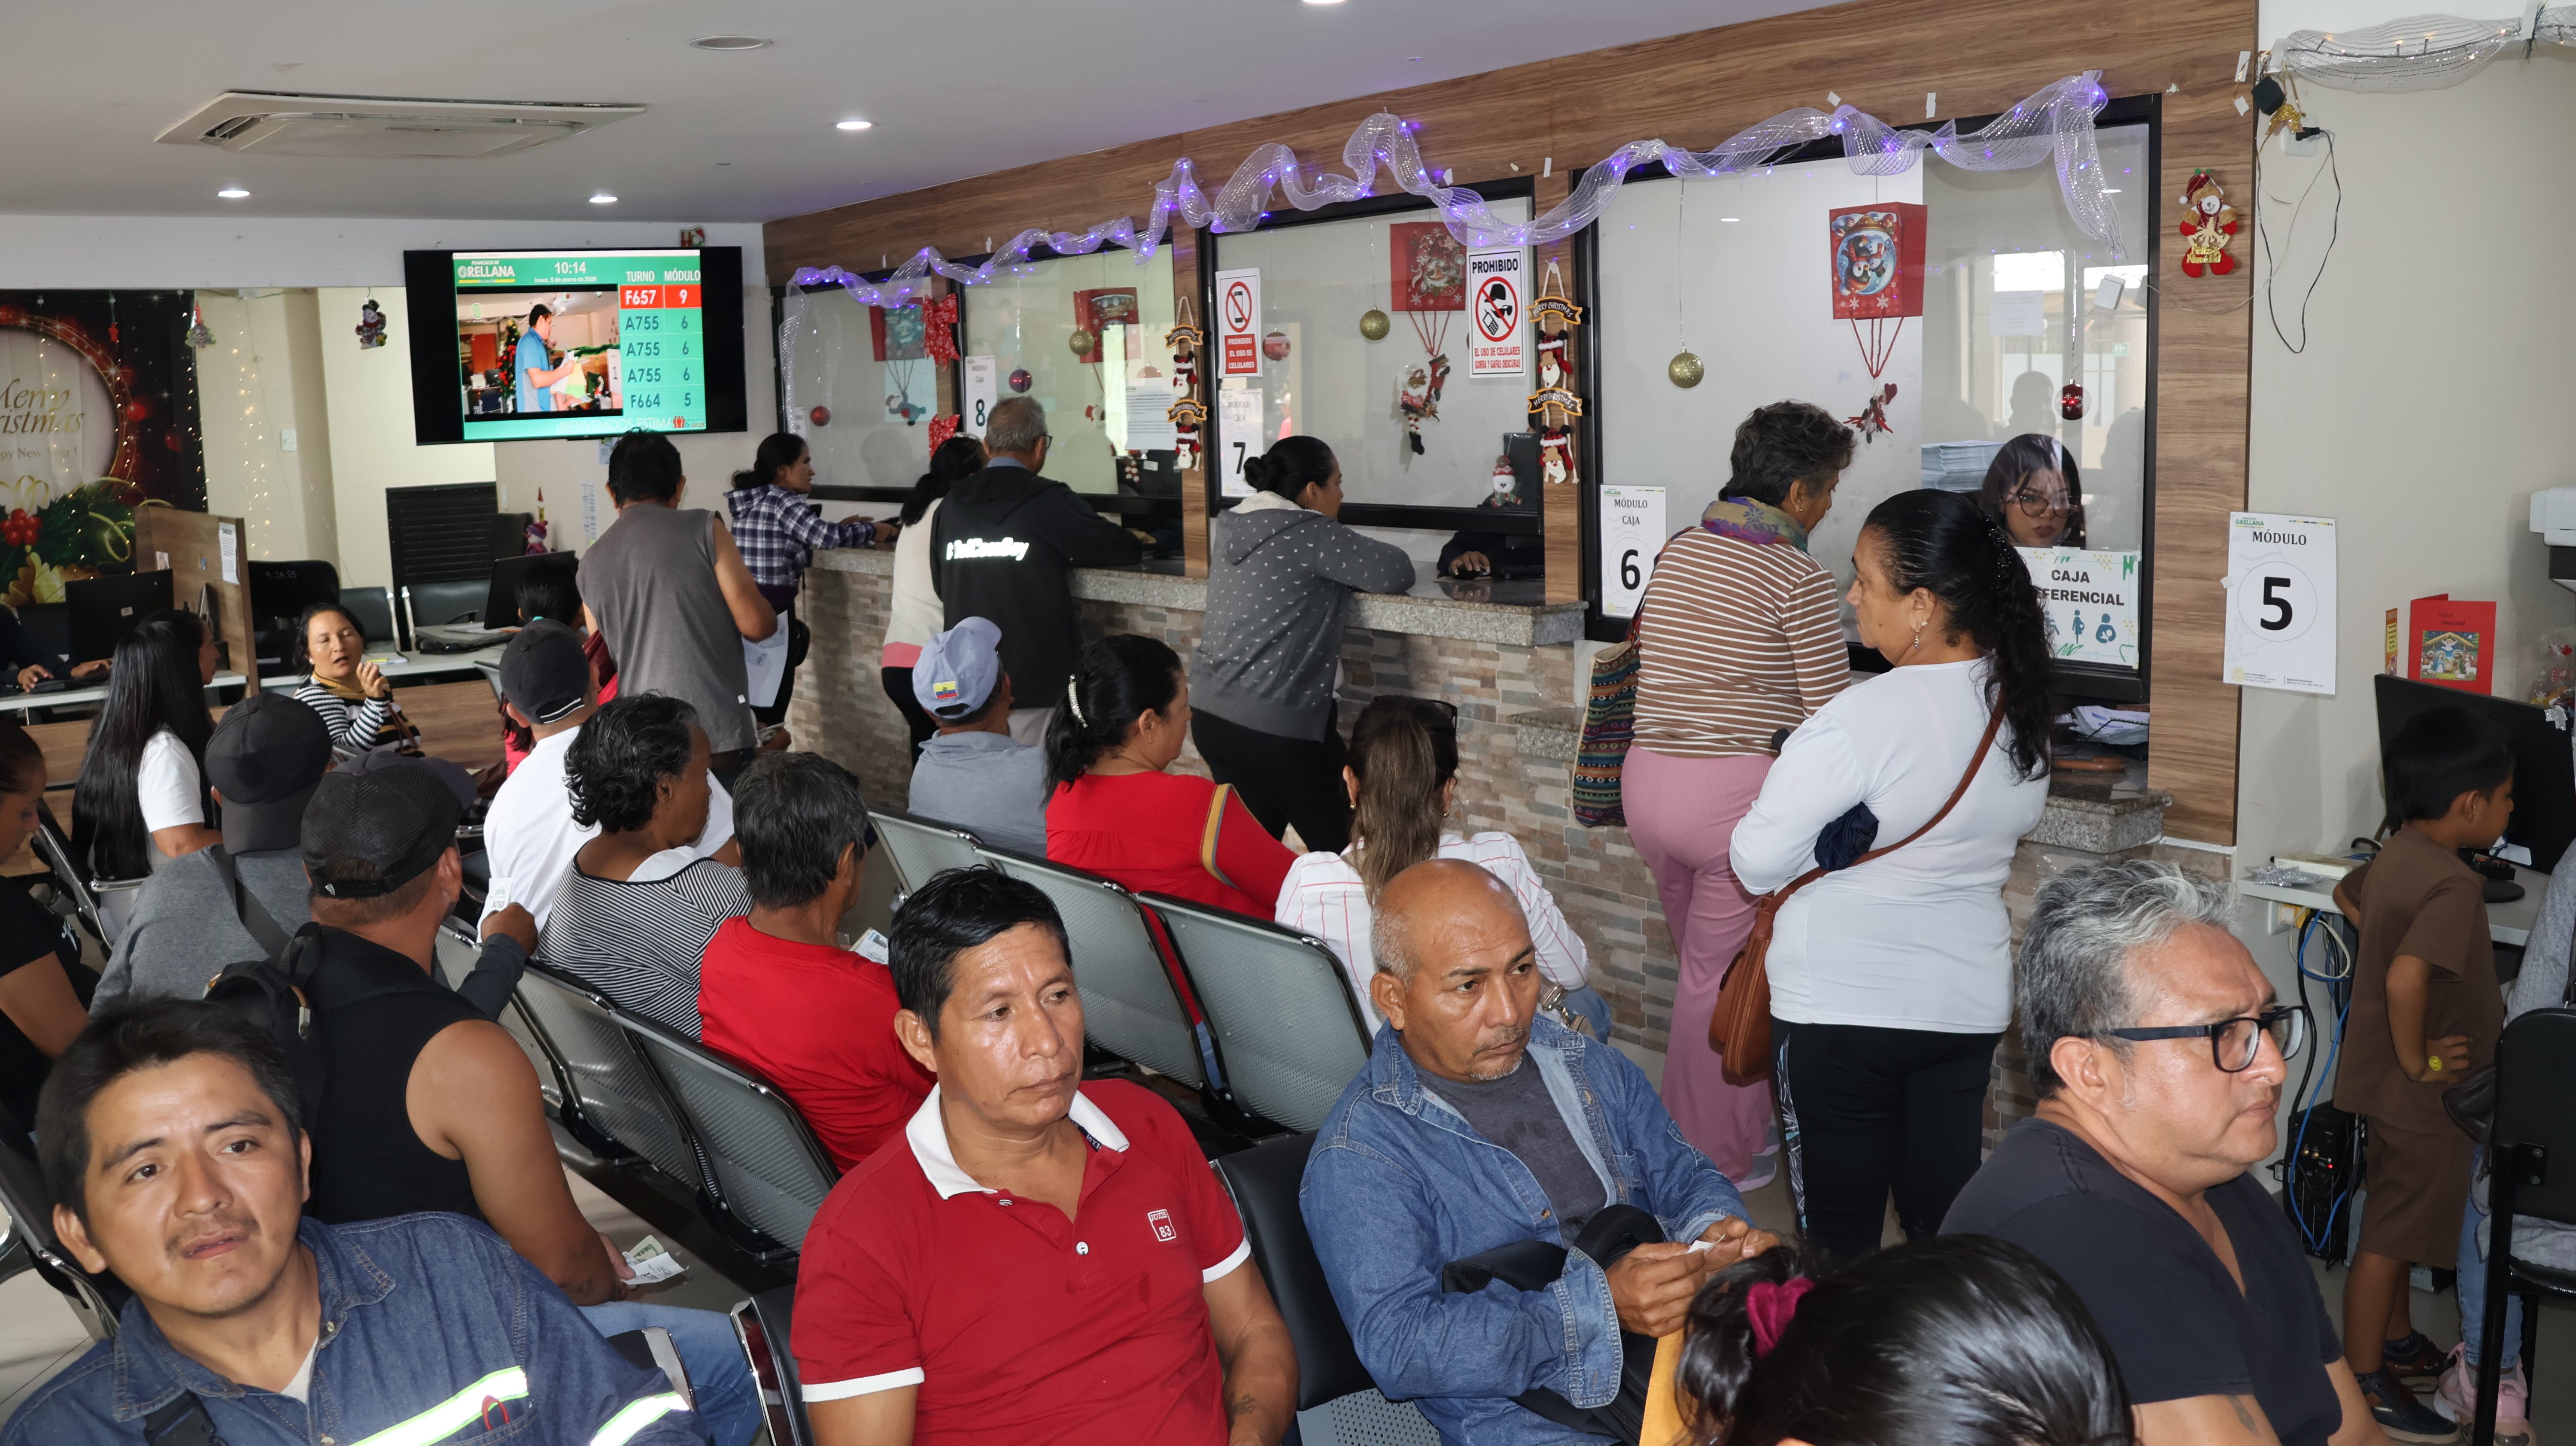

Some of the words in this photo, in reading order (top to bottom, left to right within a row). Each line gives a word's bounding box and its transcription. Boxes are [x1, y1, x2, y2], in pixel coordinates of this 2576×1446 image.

[458, 265, 515, 278] ORELLANA
[554, 261, 586, 274] 10:14
[1472, 258, 1518, 274] PROHIBIDO
[626, 271, 655, 282] TURNO
[664, 268, 701, 281] MÓDULO
[625, 289, 656, 305] F657
[679, 289, 687, 304] 9
[1533, 302, 1547, 316] MERRY
[1547, 302, 1573, 317] CHRISTMAS
[625, 316, 659, 331] A755
[681, 315, 688, 329] 6
[626, 341, 660, 357] A755
[682, 341, 689, 355] 6
[1475, 348, 1479, 356] EL
[1481, 348, 1489, 356] USO
[1490, 347, 1496, 356] DE
[1497, 346, 1520, 355] CELULARES
[1475, 360, 1486, 369] GORRA
[1487, 360, 1490, 368] Y
[1491, 360, 1501, 368] GAFAS
[1503, 359, 1520, 368] OBSCURAS
[627, 368, 661, 383] A755
[683, 367, 690, 381] 6
[631, 393, 661, 408] F664
[684, 392, 691, 406] 5
[1228, 399, 1250, 408] MÓDULO
[1534, 394, 1547, 407] MERRY
[1547, 393, 1574, 409] CHRISTMAS
[976, 398, 986, 427] 8
[0, 409, 85, 434] istmas
[18, 447, 41, 458] New
[1233, 441, 1246, 474] 7
[1614, 497, 1648, 508] MÓDULO
[1622, 516, 1640, 526] CAJA
[2252, 529, 2307, 545] MÓDULO
[1621, 549, 1641, 590] 6
[2051, 569, 2090, 583] CAJA
[2042, 588, 2124, 606] FERENCIAL
[2260, 576, 2293, 631] 5
[1159, 1225, 1172, 1237] 83
